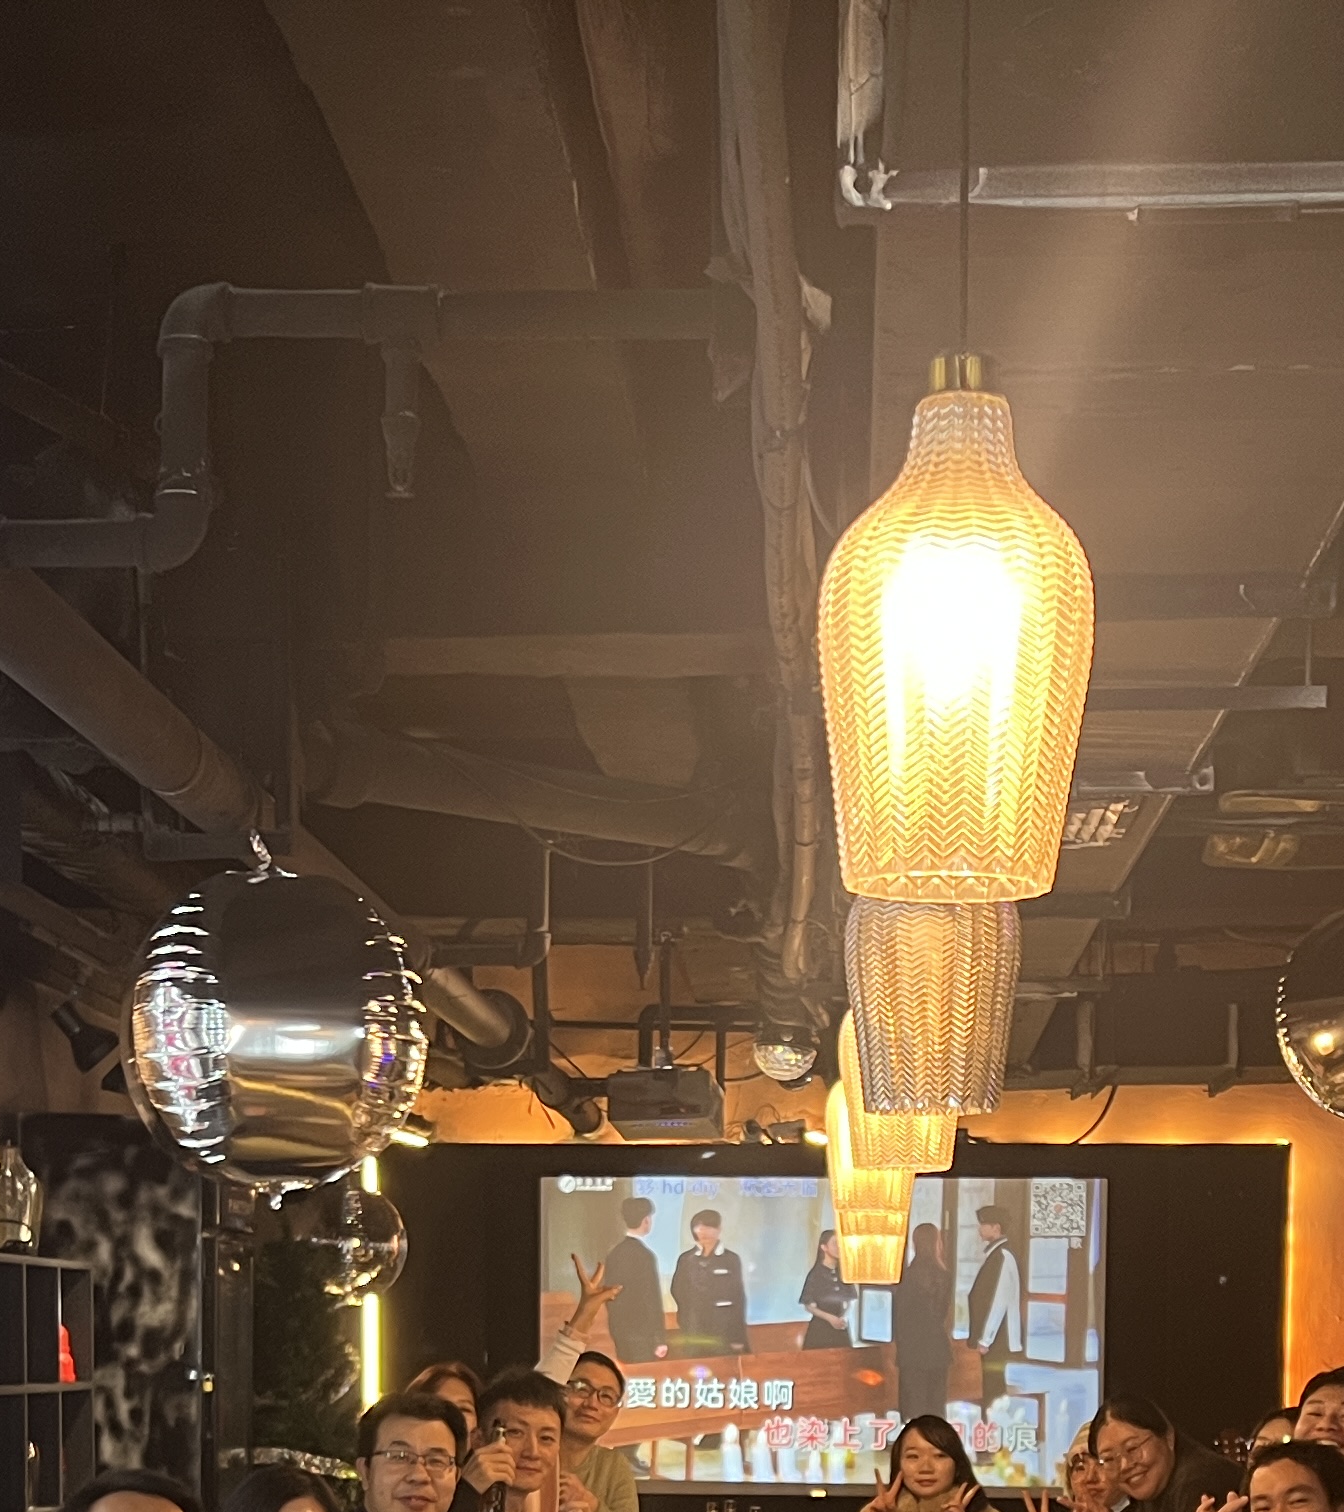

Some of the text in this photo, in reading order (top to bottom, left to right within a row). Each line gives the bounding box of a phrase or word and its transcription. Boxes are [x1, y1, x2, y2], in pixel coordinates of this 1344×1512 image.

[617, 1378, 794, 1411] 愛的姑娘啊
[764, 1415, 1040, 1454] 也染上了的痕
